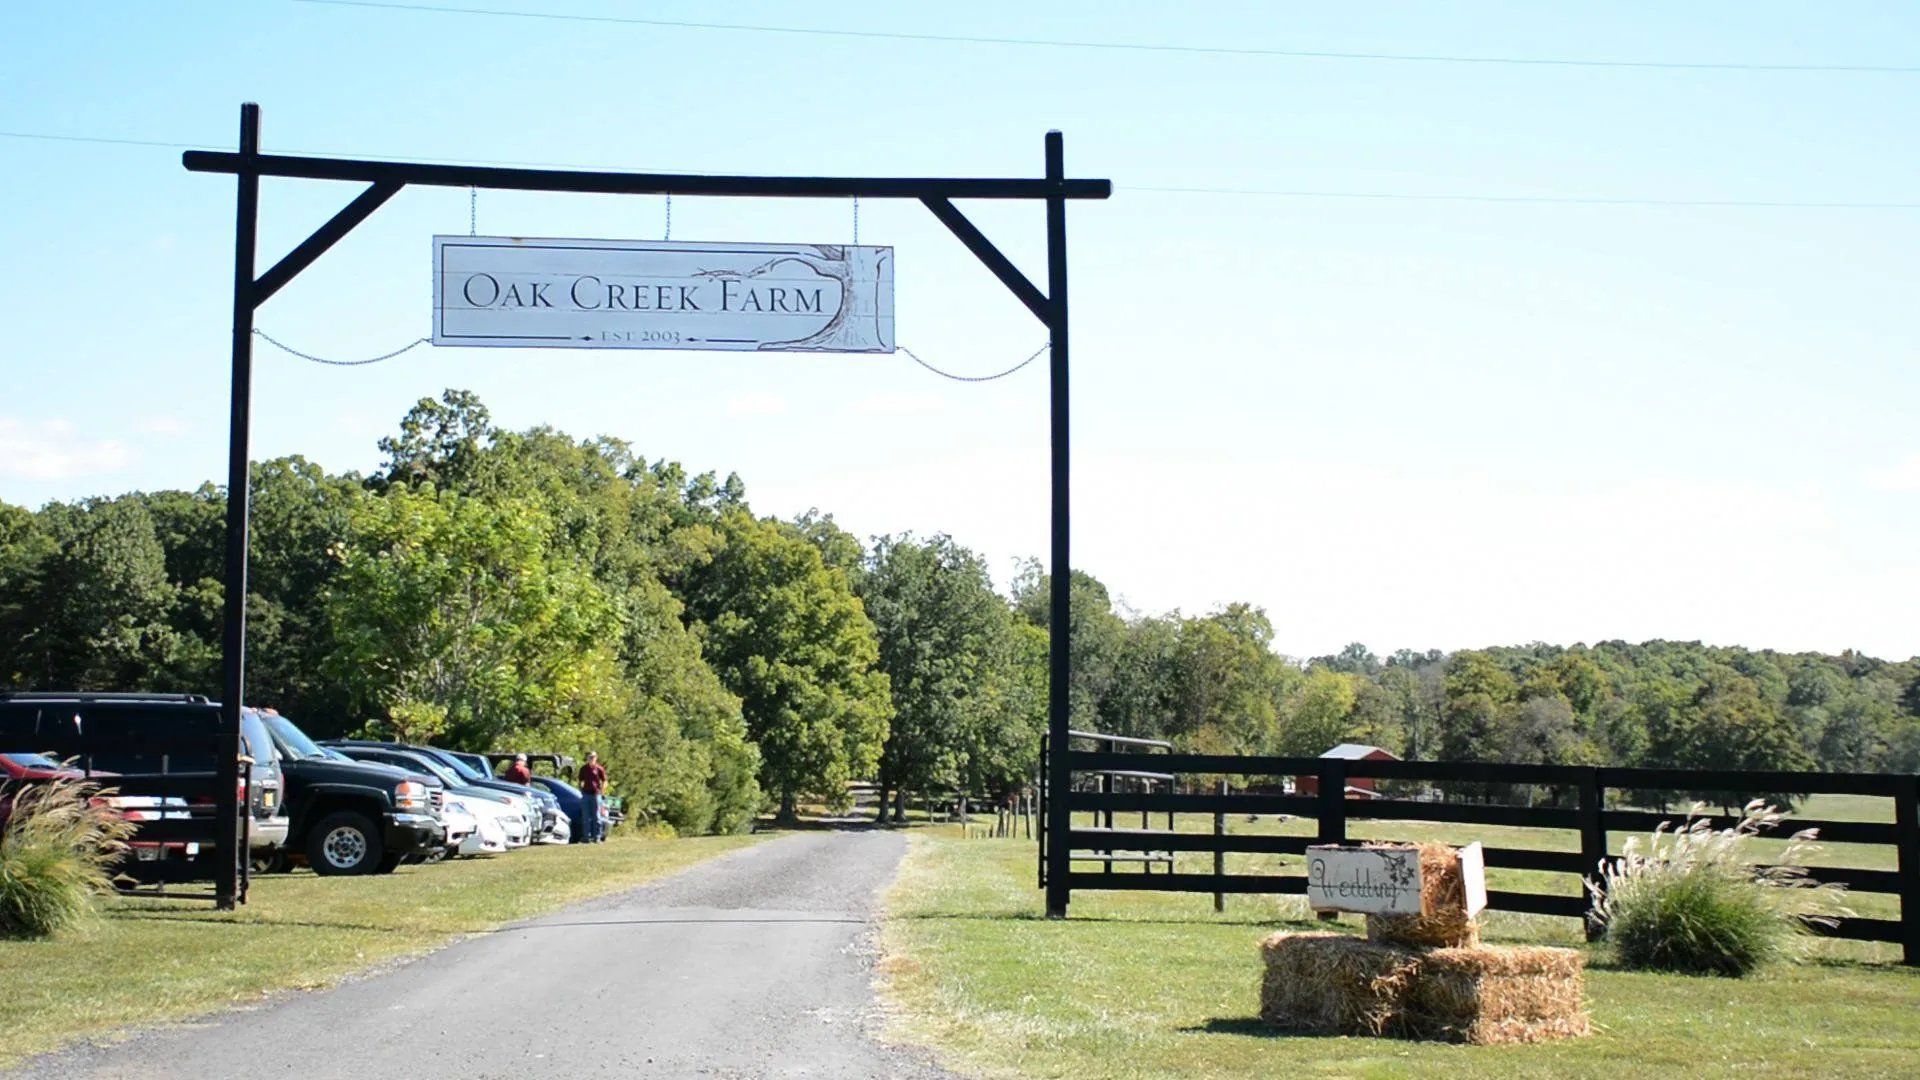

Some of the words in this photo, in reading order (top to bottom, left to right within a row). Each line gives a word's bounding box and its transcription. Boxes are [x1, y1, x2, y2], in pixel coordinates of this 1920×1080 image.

[463, 272, 554, 308] OAK
[570, 275, 702, 312] CREEK
[720, 279, 823, 313] FARM
[641, 330, 681, 345] 2003
[1311, 858, 1398, 908] Wedding
